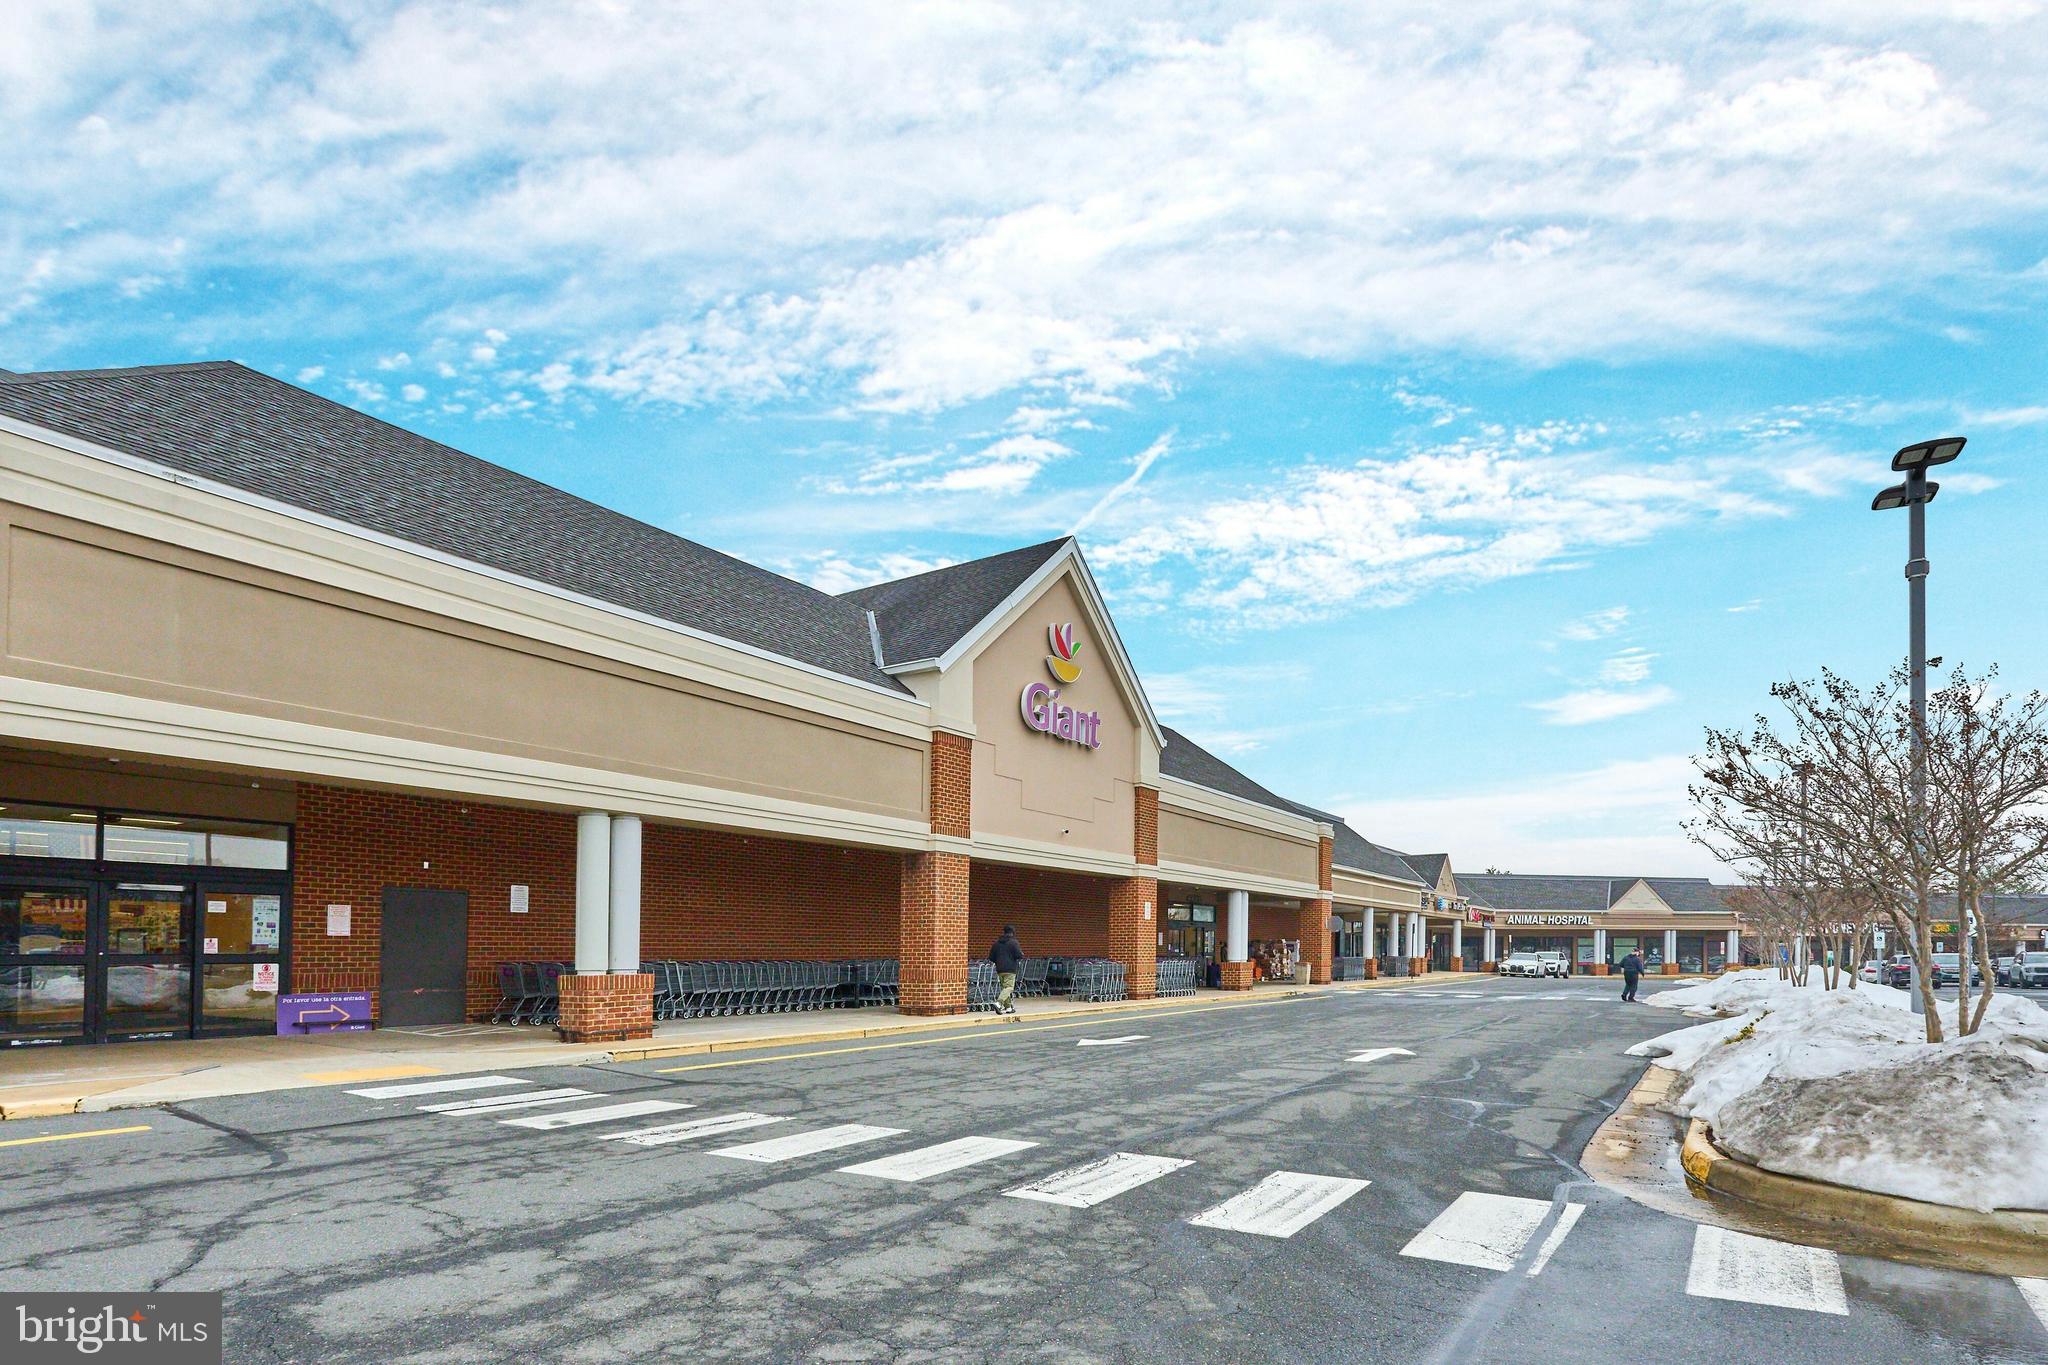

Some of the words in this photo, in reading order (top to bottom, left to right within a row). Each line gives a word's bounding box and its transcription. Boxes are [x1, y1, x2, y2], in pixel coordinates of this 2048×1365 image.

[1021, 682, 1101, 749] Giant
[1507, 914, 1544, 925] ANIMAL
[1547, 915, 1594, 925] HOSPITAL
